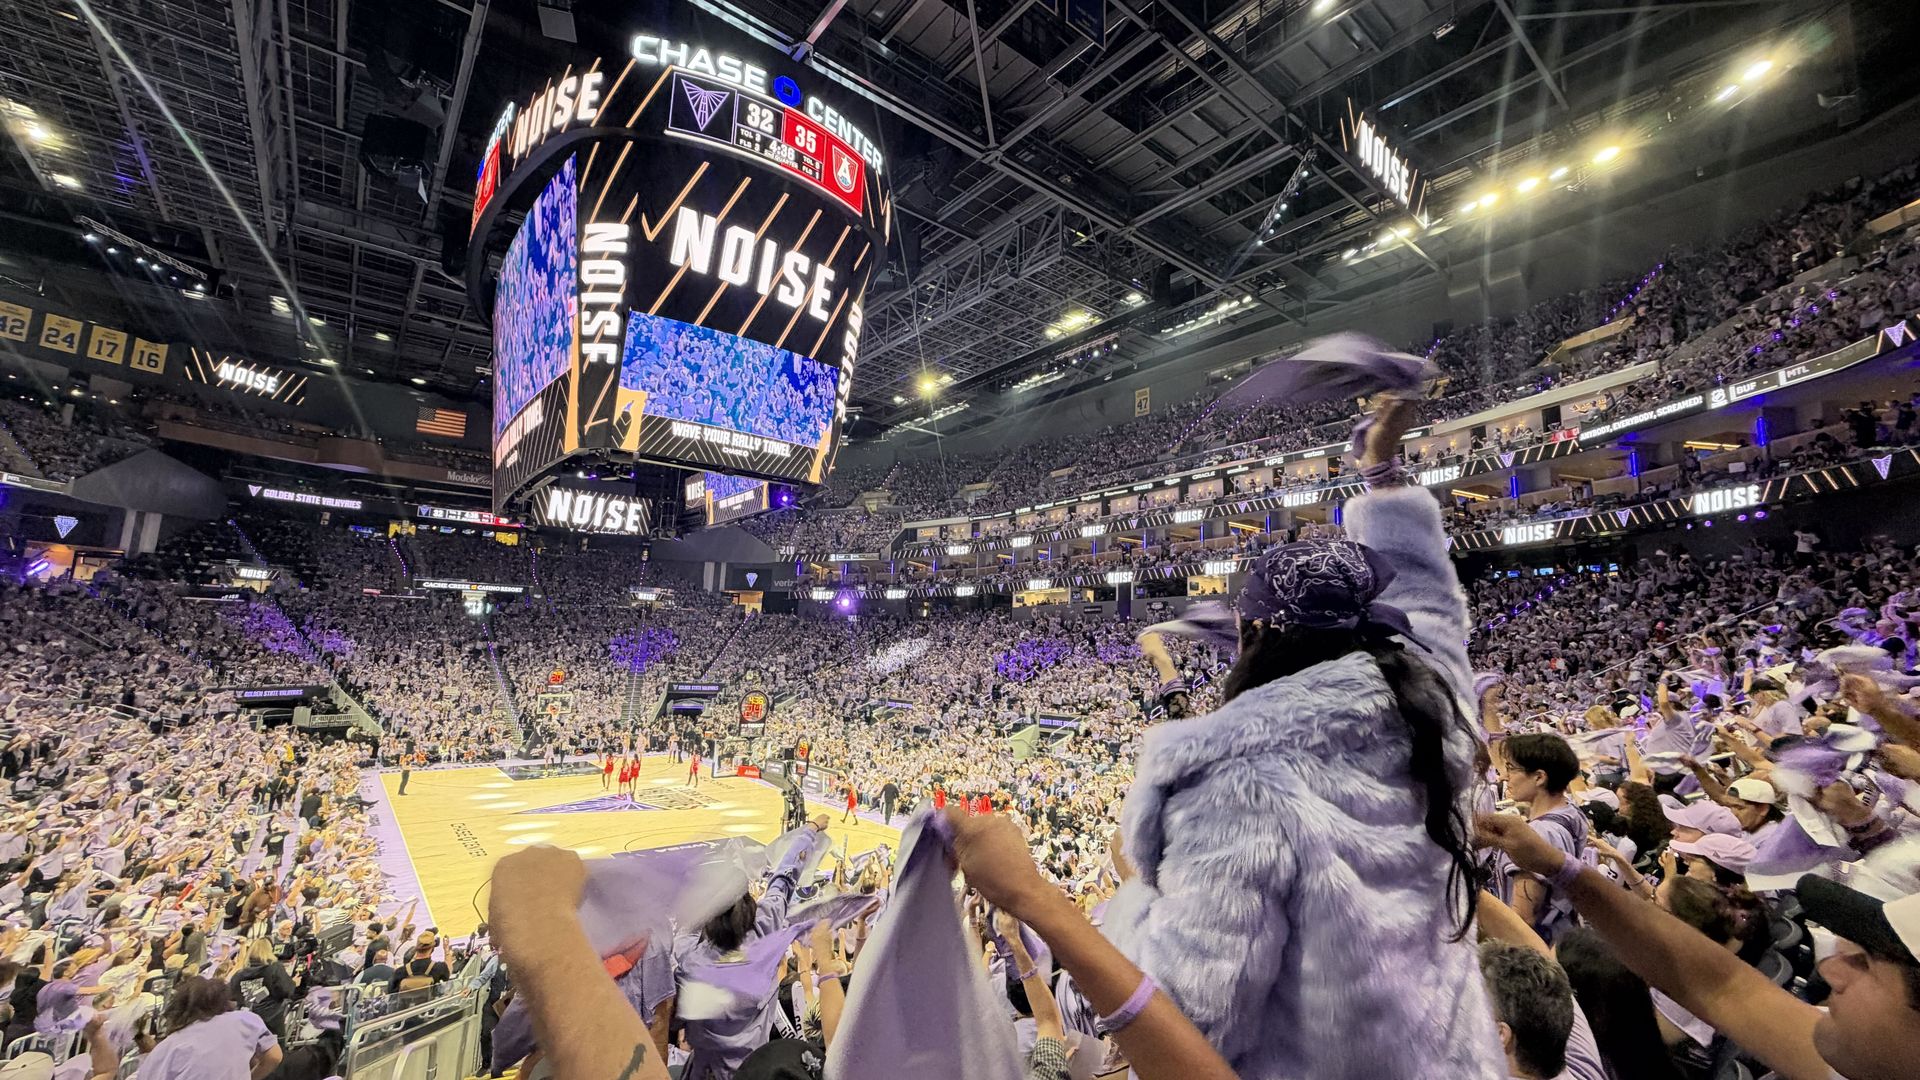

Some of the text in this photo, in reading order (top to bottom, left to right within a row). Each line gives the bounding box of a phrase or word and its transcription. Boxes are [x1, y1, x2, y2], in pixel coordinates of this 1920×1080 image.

[632, 35, 884, 175] CHASE CENTER
[513, 71, 601, 159] NOISE
[746, 103, 774, 133] 32
[794, 124, 817, 153] 35
[775, 156, 799, 169] QUARTER
[1359, 120, 1409, 204] NOISE
[670, 206, 836, 322] NOISE
[580, 222, 630, 365] NOISE
[44, 327, 76, 349] 24
[95, 339, 119, 358] 17
[137, 351, 160, 369] 16
[218, 363, 278, 393] NOISE
[1787, 366, 1810, 378] MTL
[1736, 382, 1757, 395] BUF
[1137, 401, 1148, 410] 47
[1579, 425, 1613, 441] ANYBODY,
[1613, 410, 1657, 431] EVERYBODY,
[1657, 396, 1703, 416] SCREAMED!
[672, 421, 791, 457] WAVE YOUR RALLY TOWEL
[722, 447, 744, 456] CHASE
[1304, 450, 1325, 458] verizon
[1265, 457, 1284, 466] HPE
[447, 471, 478, 483] Modelo
[1192, 471, 1216, 479] ORACLE
[1421, 466, 1461, 486] NOISE
[263, 489, 362, 510] GOLDEN STATE VALKYRIES
[1284, 492, 1319, 507] NOISE
[1694, 484, 1762, 515] NOISE
[547, 489, 643, 532] NOISE
[1174, 510, 1203, 523] NOISE
[1082, 525, 1105, 537] NOISE
[1503, 523, 1555, 544] NOISE
[948, 545, 969, 555] NOISE
[1012, 537, 1032, 548] NOISE
[240, 568, 268, 579] NOISE
[1205, 561, 1238, 576] NOISE
[1028, 579, 1050, 590] NOISE
[1107, 571, 1133, 584] NOISE
[886, 590, 906, 599] NOISE
[957, 586, 975, 597] NOISE
[741, 704, 763, 718] 24
